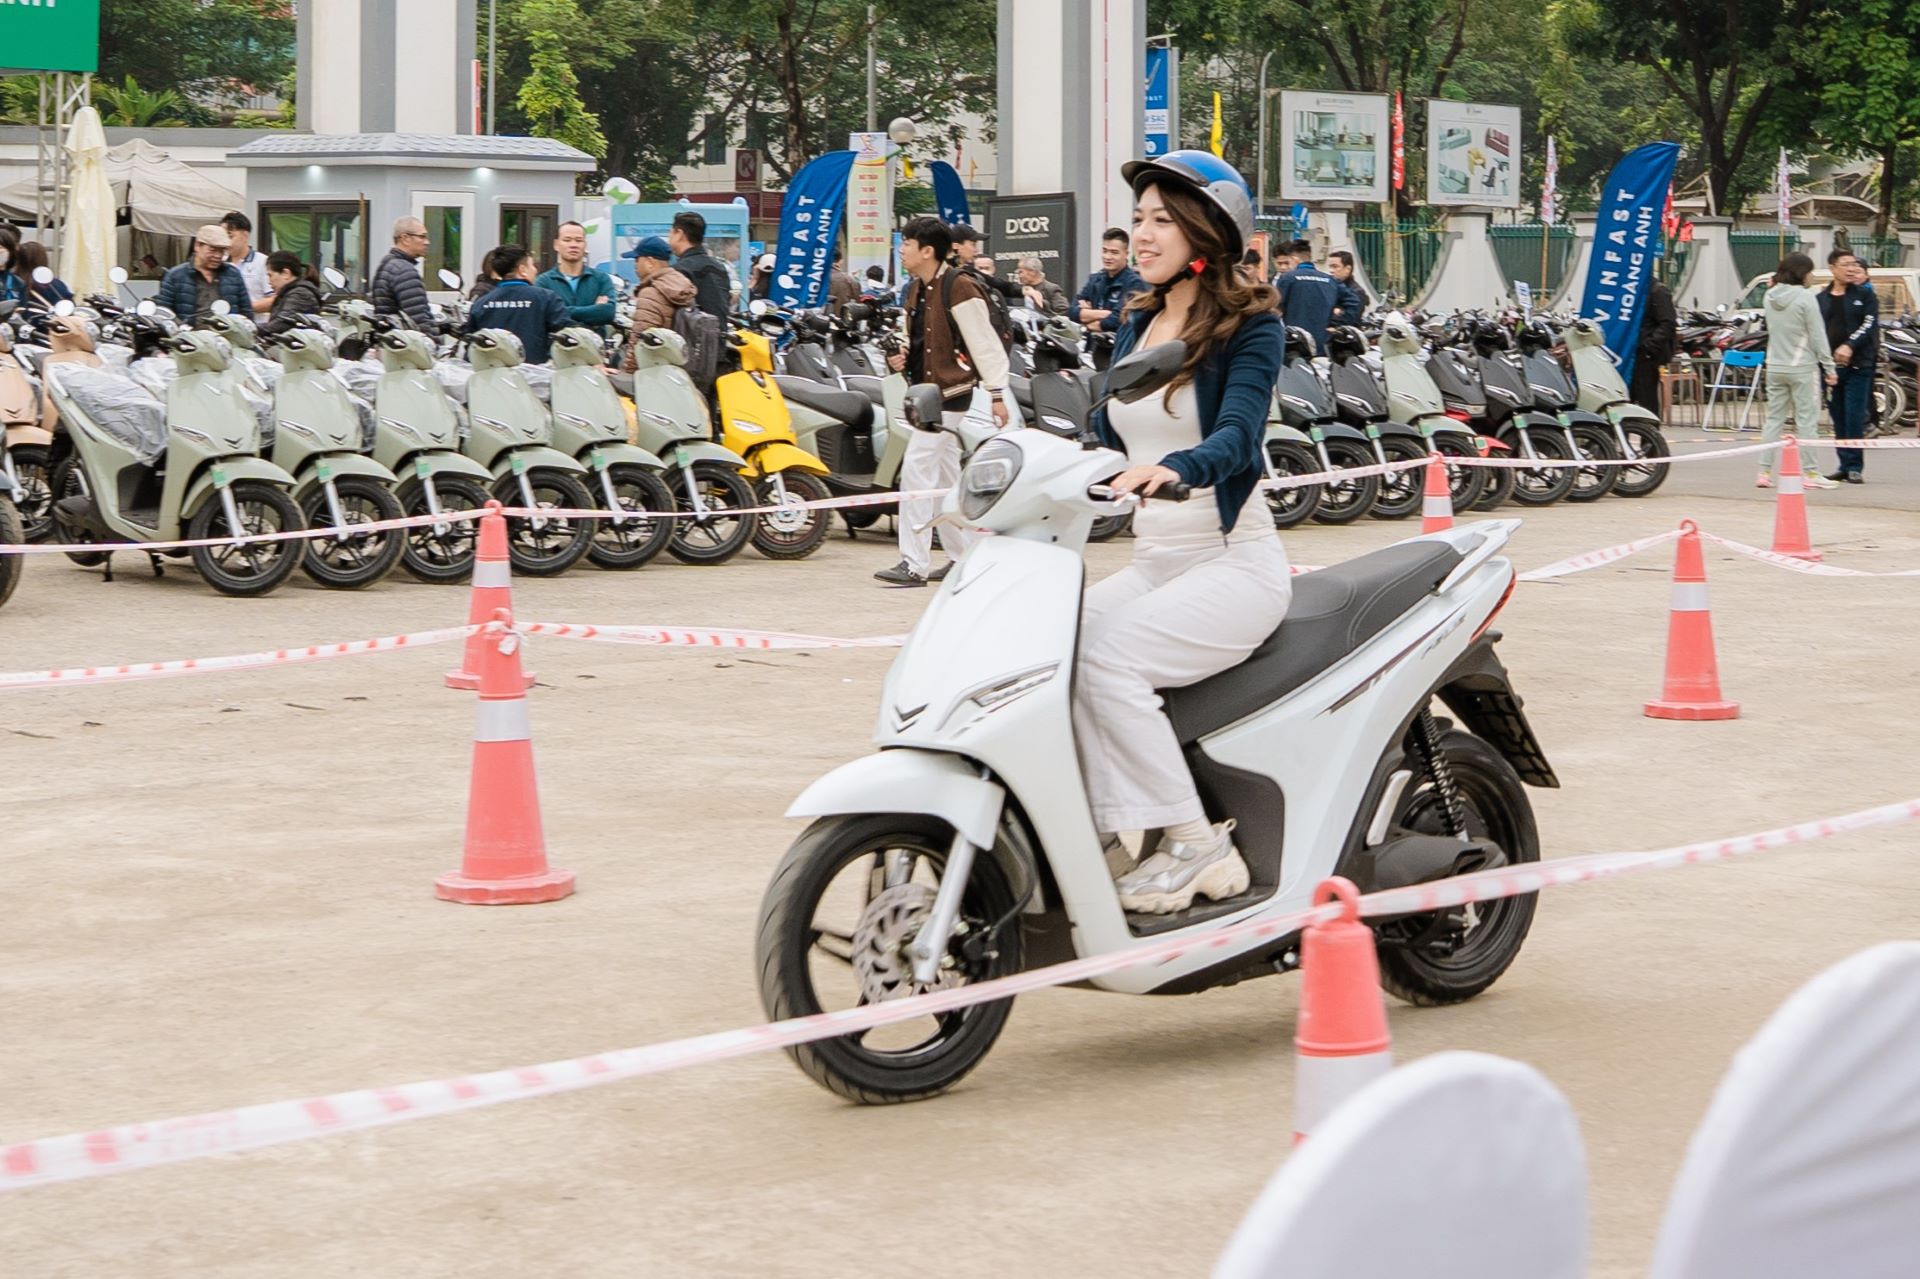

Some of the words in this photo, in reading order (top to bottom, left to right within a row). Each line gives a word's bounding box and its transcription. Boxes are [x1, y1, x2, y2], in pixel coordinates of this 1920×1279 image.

[816, 208, 833, 243] ANH
[1634, 206, 1653, 248] ANH
[1593, 188, 1635, 322] VINFAST
